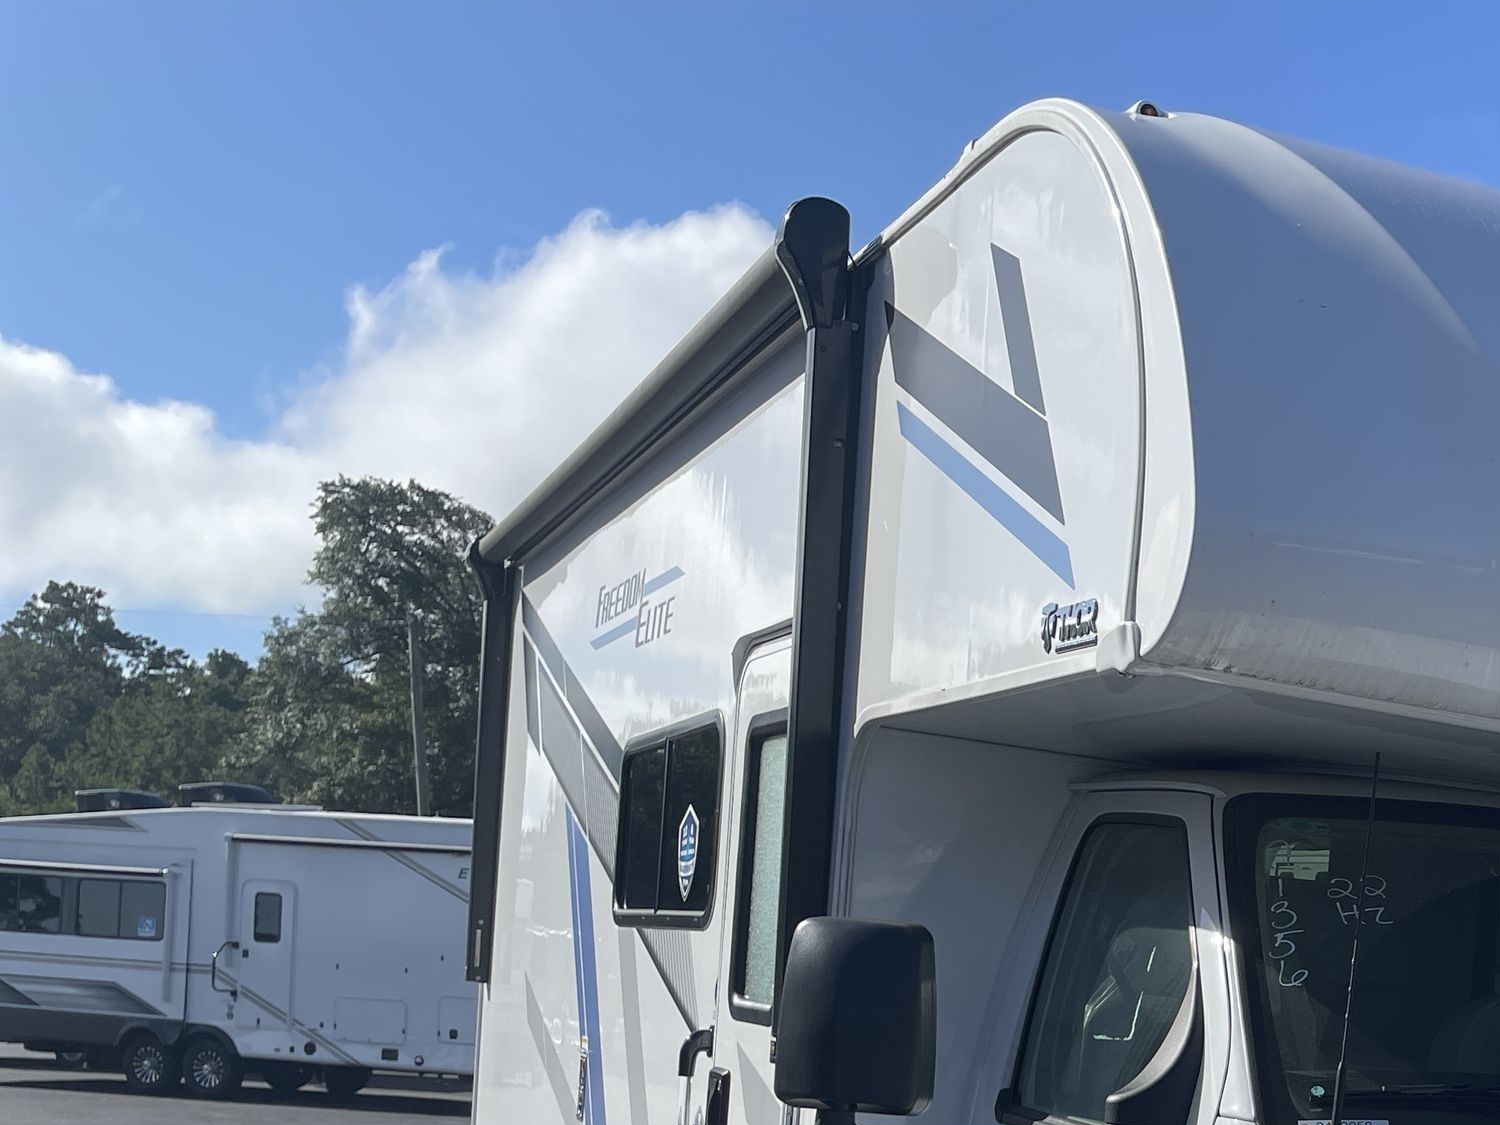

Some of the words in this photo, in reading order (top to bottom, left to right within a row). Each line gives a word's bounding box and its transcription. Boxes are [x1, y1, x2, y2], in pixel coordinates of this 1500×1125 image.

[595, 568, 647, 628] FREEDOM
[635, 596, 676, 648] ELITE
[1327, 875, 1387, 899] 22
